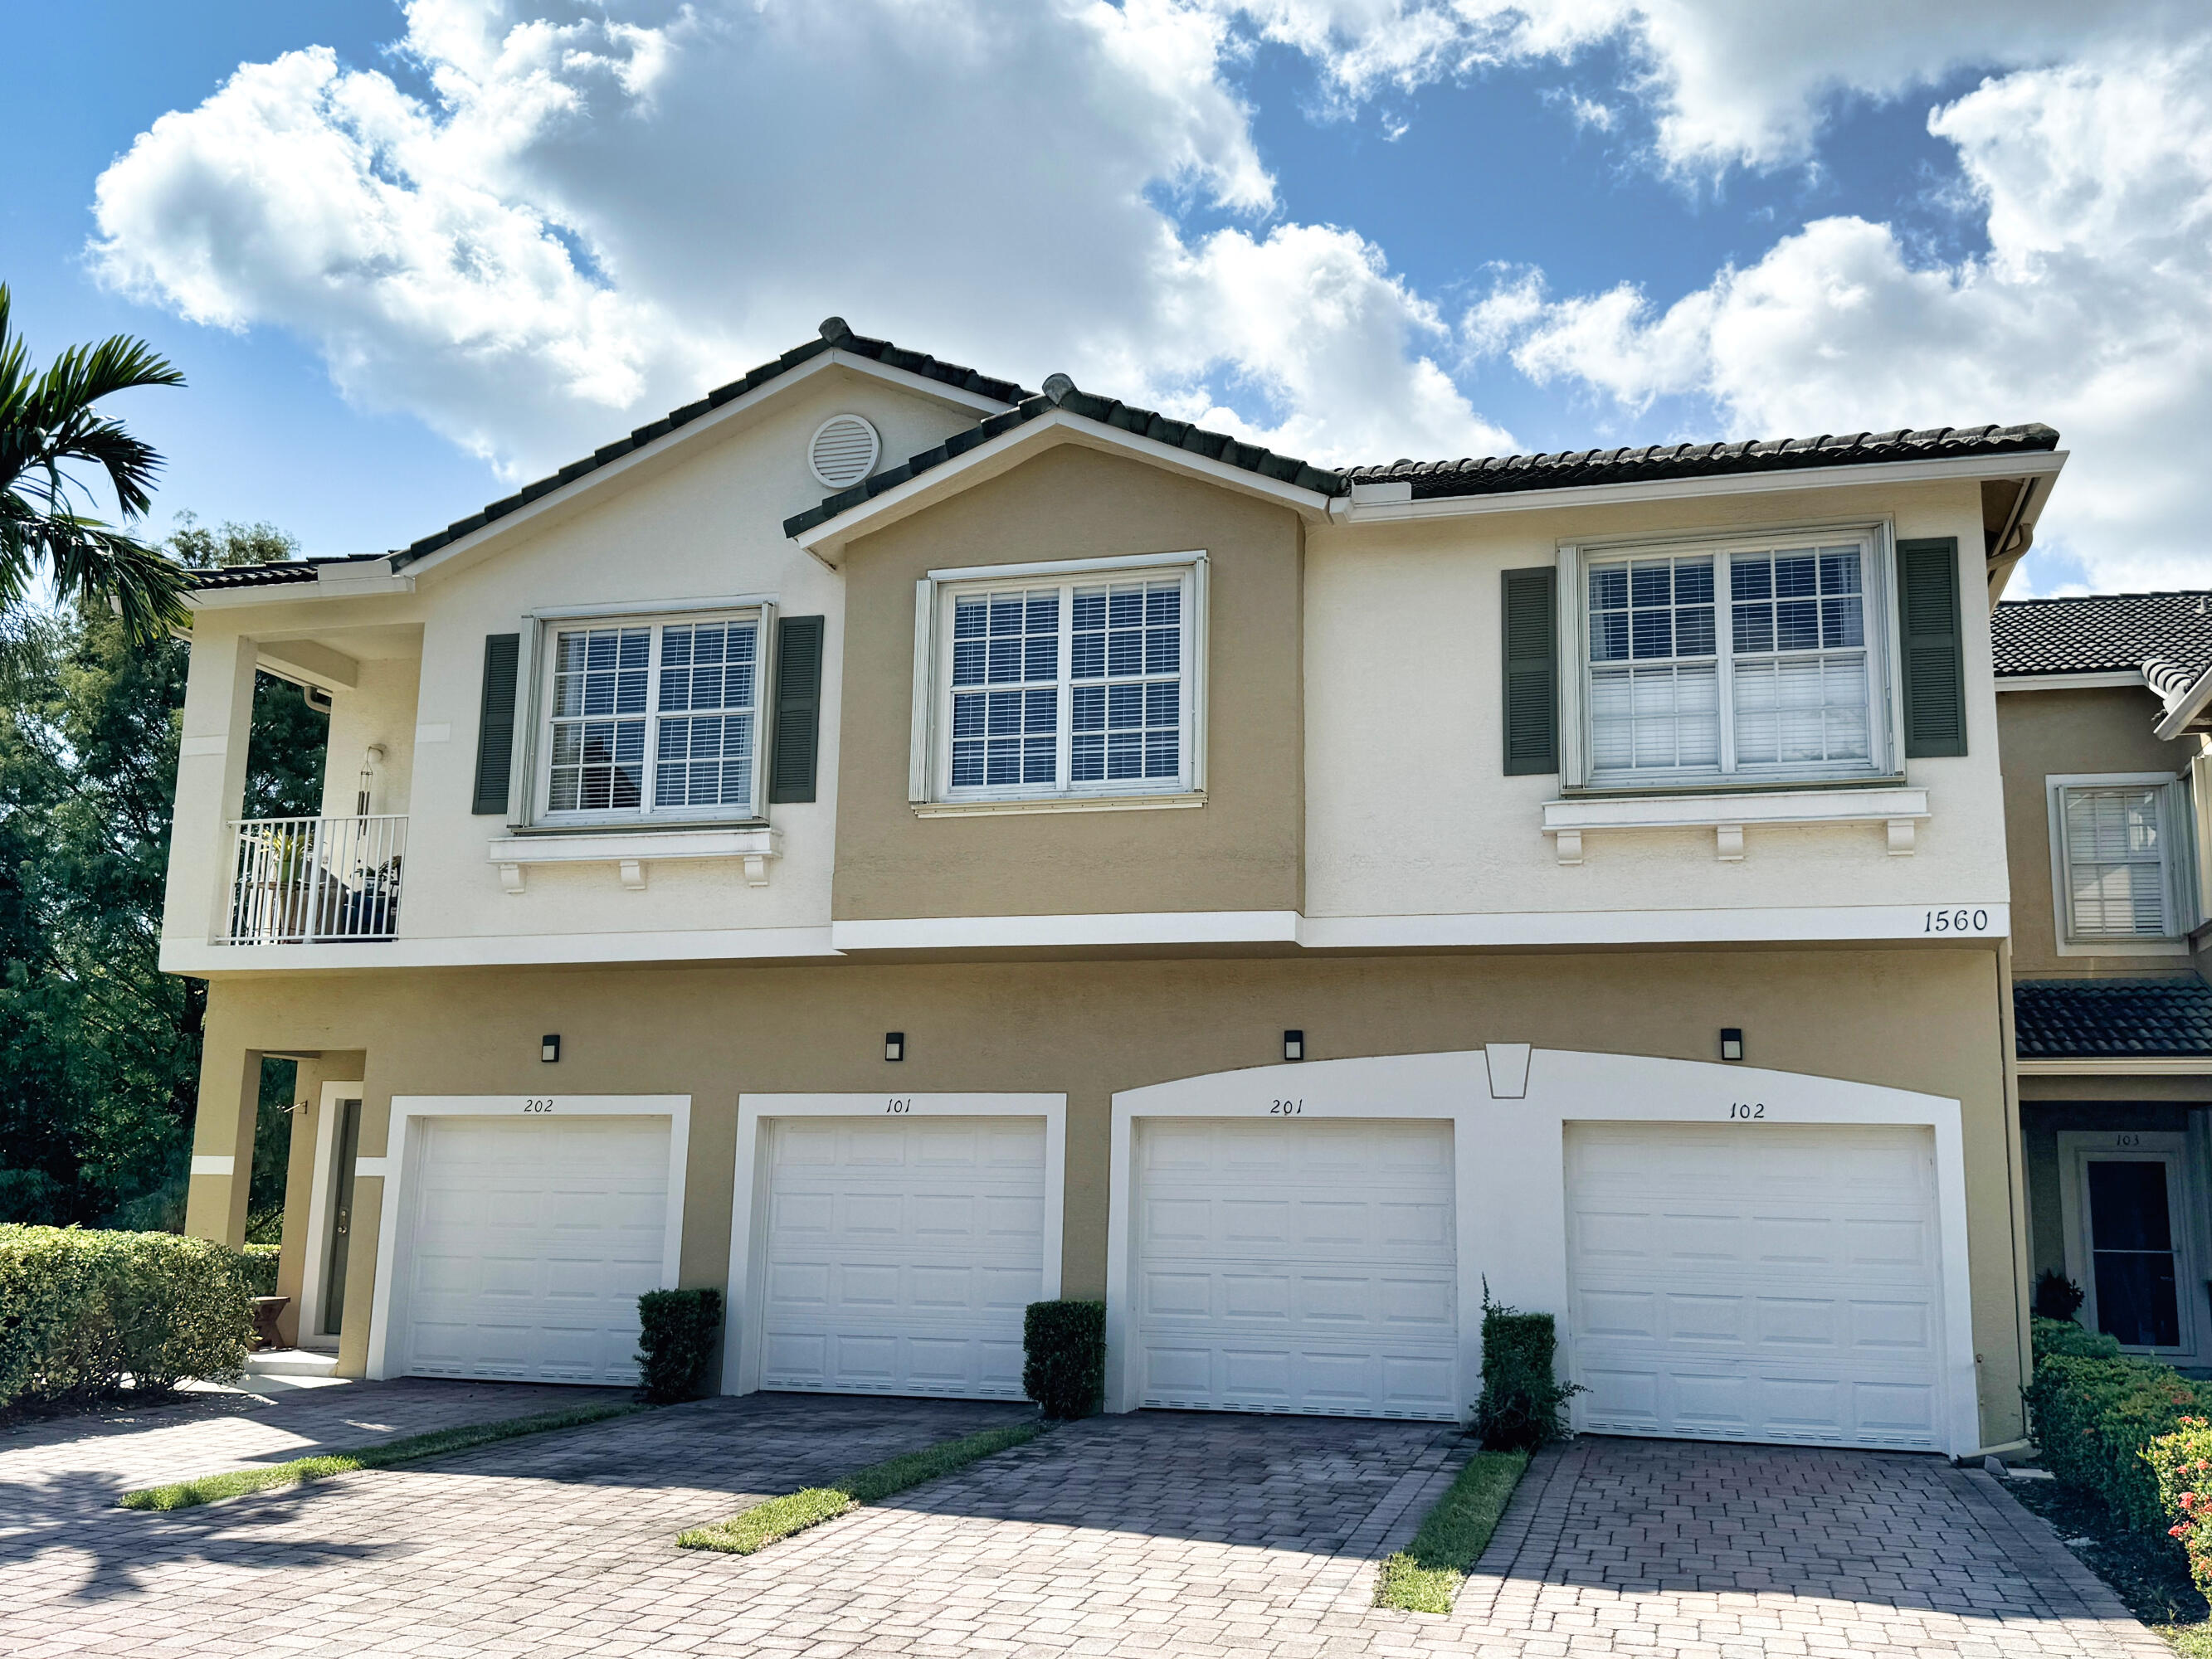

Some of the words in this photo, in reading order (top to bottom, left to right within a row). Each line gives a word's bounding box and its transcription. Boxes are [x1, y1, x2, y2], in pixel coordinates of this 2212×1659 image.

[1924, 910, 1988, 932] 1560
[524, 1099, 553, 1112] 202
[886, 1098, 911, 1113] 101
[1269, 1099, 1303, 1114] 201
[1730, 1102, 1765, 1119] 102
[2117, 1134, 2140, 1146] 103
